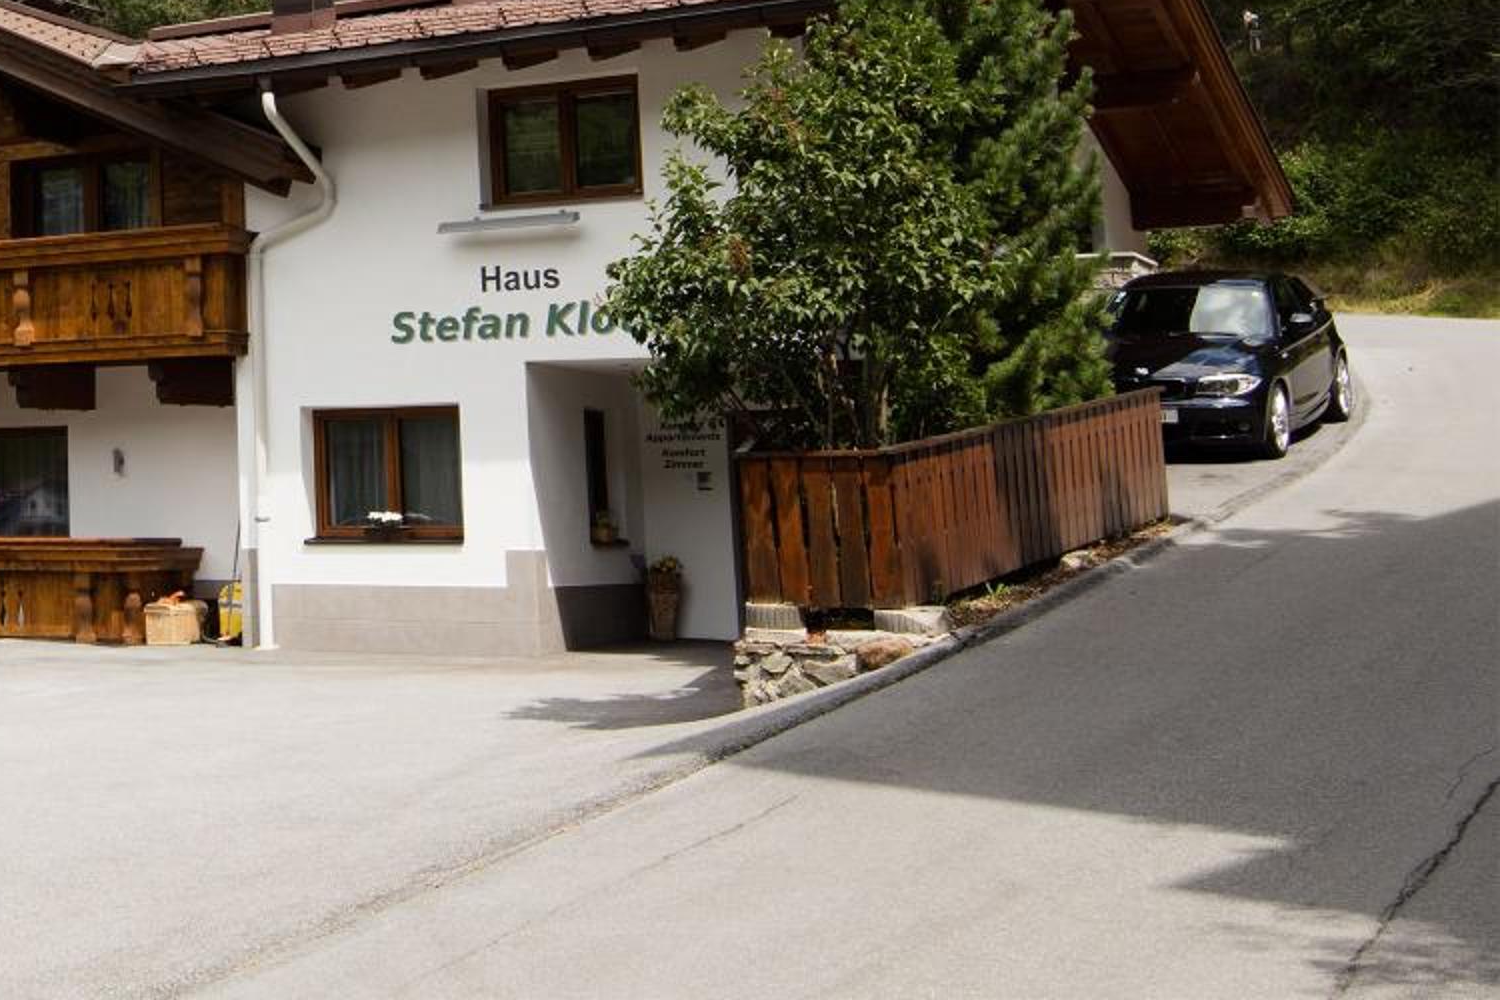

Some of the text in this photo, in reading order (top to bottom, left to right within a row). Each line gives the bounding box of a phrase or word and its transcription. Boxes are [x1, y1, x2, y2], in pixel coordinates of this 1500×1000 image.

[481, 266, 560, 291] Haus
[391, 301, 633, 343] Stefan Klo
[663, 460, 705, 469] Zimmer
